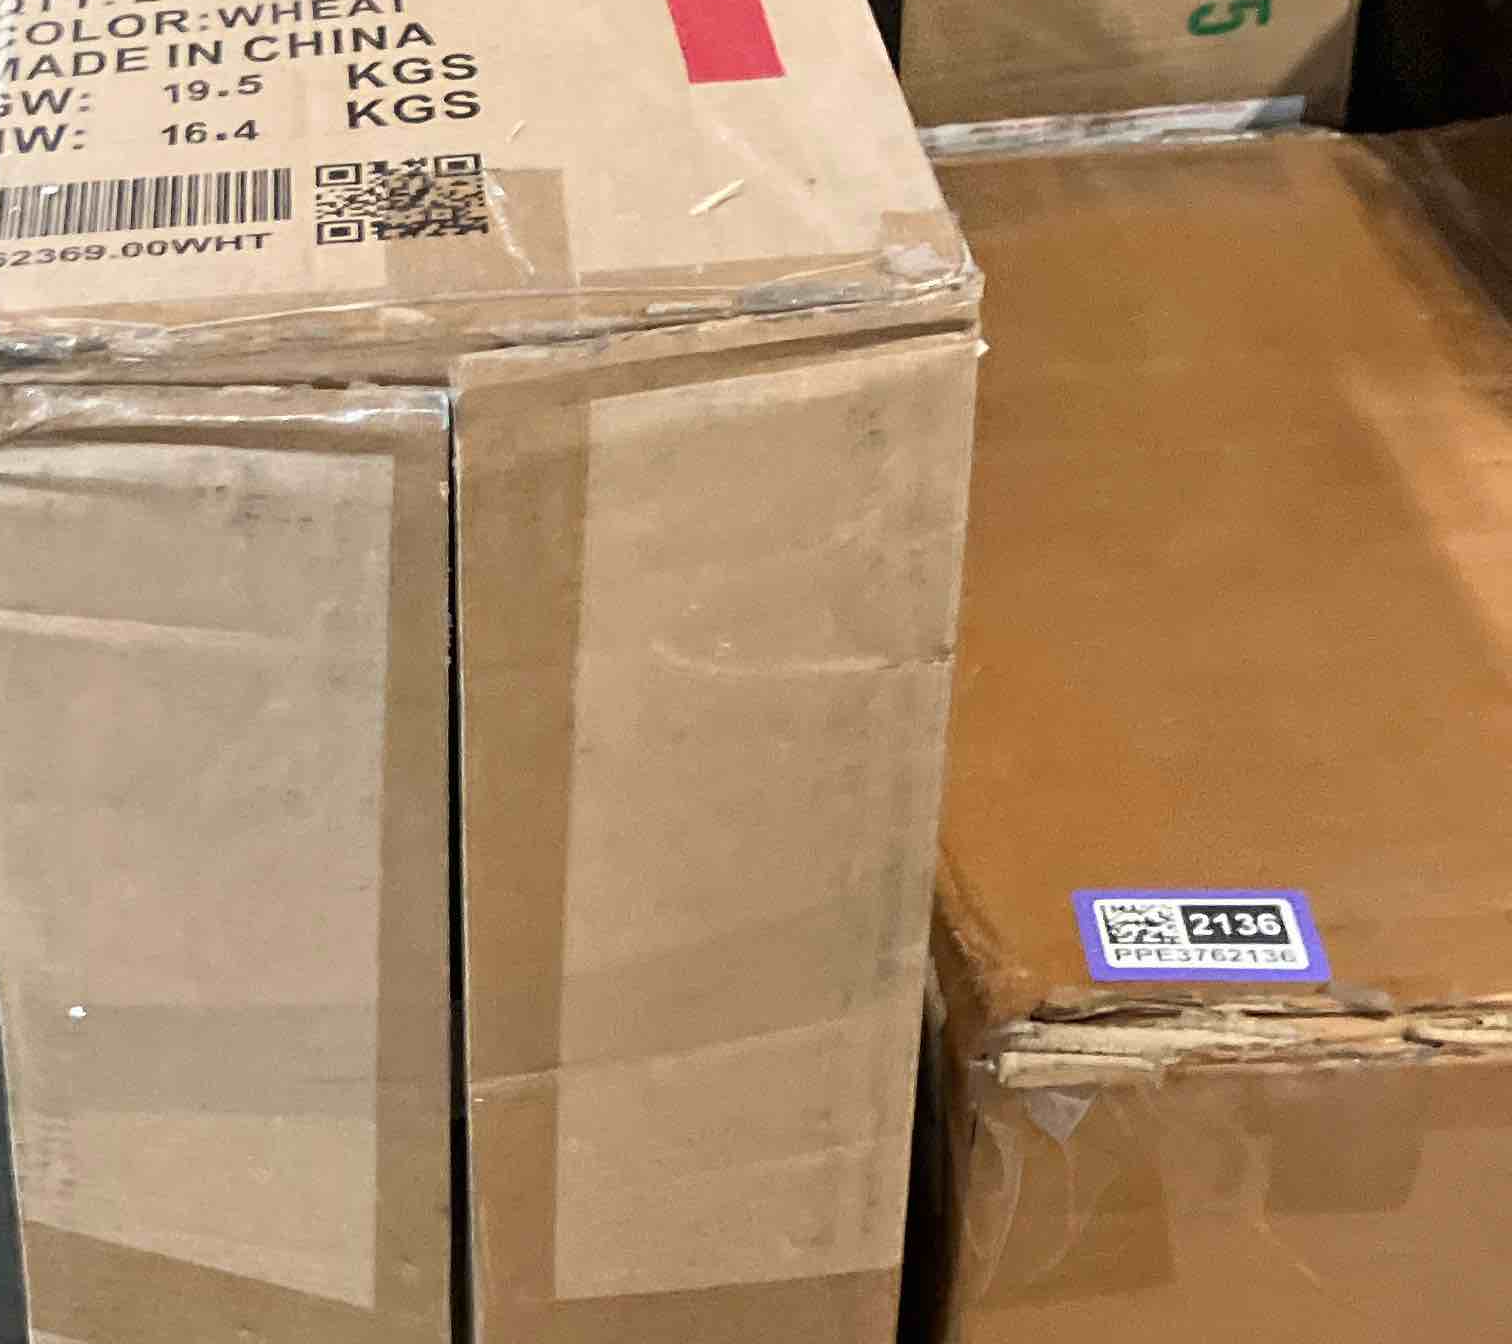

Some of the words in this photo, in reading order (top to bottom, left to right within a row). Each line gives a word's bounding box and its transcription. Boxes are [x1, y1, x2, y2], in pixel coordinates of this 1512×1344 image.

[167, 38, 225, 69] IN
[242, 21, 436, 64] CHINA
[162, 75, 264, 105] 19.5
[346, 54, 481, 90] KGS
[160, 120, 260, 146] 16.4
[345, 90, 483, 131] KGS
[1188, 912, 1282, 937] 2136
[1113, 948, 1299, 964] PPE3762136
